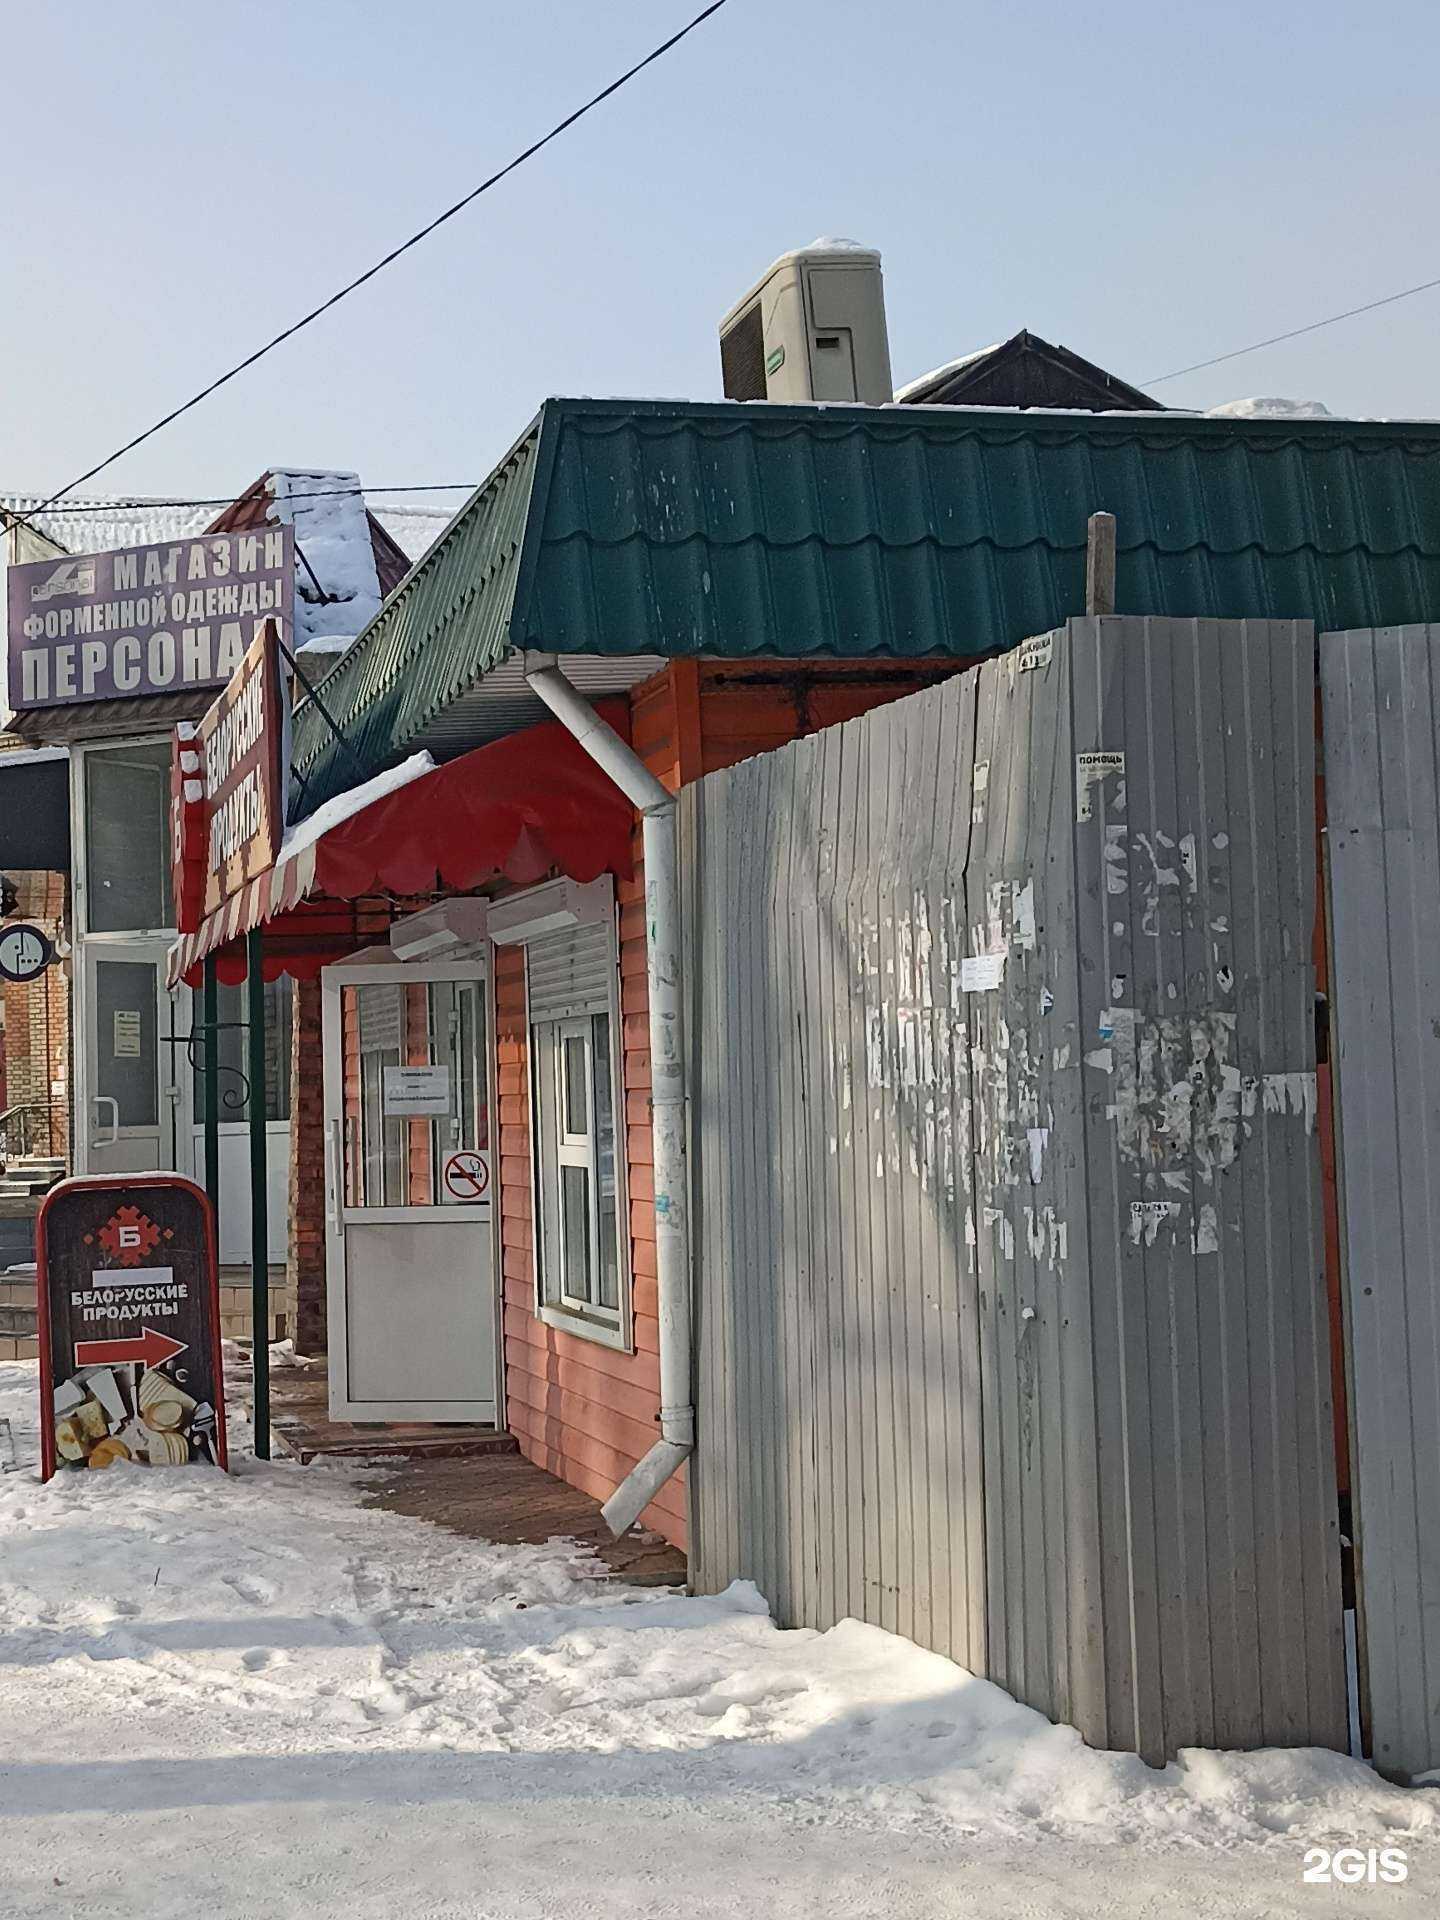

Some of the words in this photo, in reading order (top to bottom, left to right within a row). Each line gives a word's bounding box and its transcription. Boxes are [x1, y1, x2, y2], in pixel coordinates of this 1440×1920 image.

[113, 531, 284, 591] МАГАЗИН
[23, 590, 167, 640] ФОРМЕННОЙ
[171, 578, 283, 624] ОДЕЖДЫ
[207, 661, 264, 800] БЕЛОРУССКИЕ
[211, 763, 262, 874] ПРОДУКТЫ
[119, 1226, 141, 1247] Б
[71, 1284, 189, 1306] БЕЛОРУССКИЕ
[83, 1301, 179, 1321] ПРОДУКТЫ
